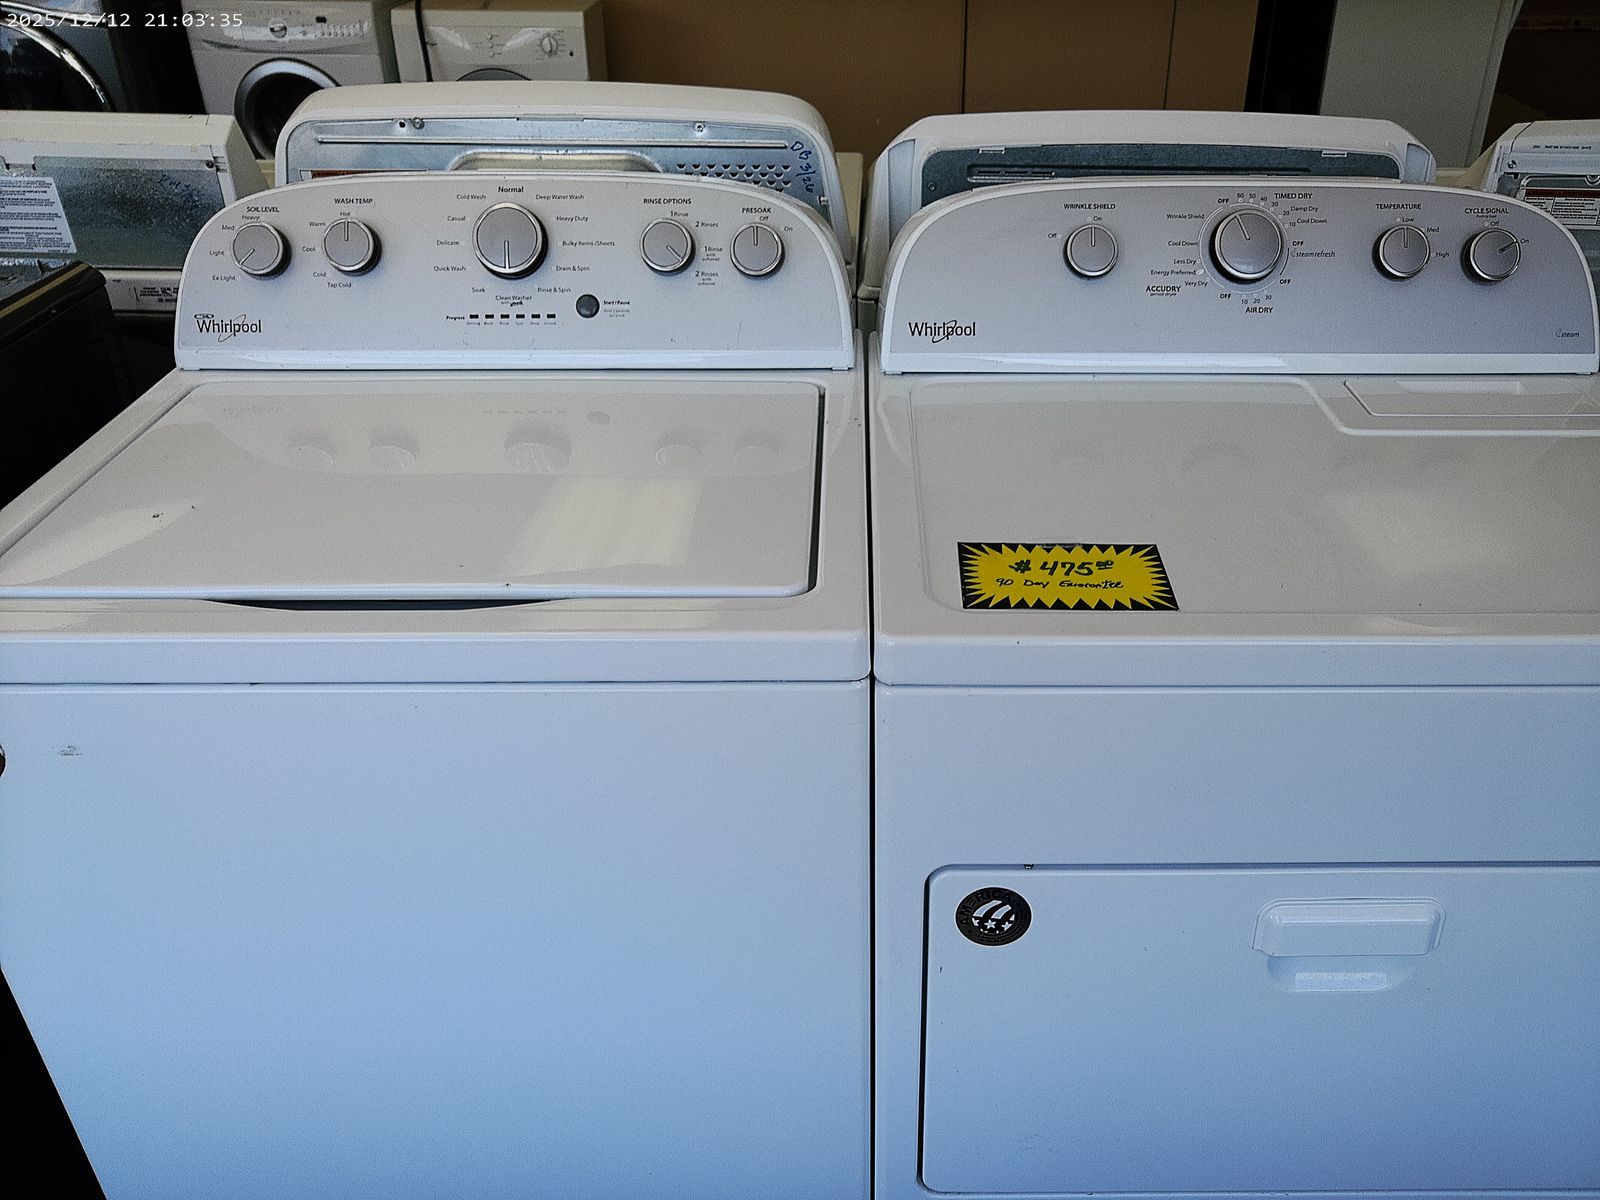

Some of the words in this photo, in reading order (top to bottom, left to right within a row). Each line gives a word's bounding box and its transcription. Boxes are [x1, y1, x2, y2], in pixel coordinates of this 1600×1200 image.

[1290, 205, 1306, 213] Damp
[1306, 205, 1318, 213] Dry
[242, 214, 260, 222] Heavy
[556, 215, 574, 223] Heavy
[574, 215, 589, 223] Duty
[1295, 250, 1336, 258] steamrefresh
[1186, 258, 1197, 266] Dry
[577, 265, 590, 273] Spin
[1184, 280, 1196, 288] Very
[1195, 280, 1208, 288] Dry
[1145, 285, 1182, 293] ACCUDRY
[196, 318, 262, 337] Whirlpool
[908, 321, 976, 340] Whirlpool
[996, 578, 1014, 586] 90
[1023, 579, 1049, 588] Day
